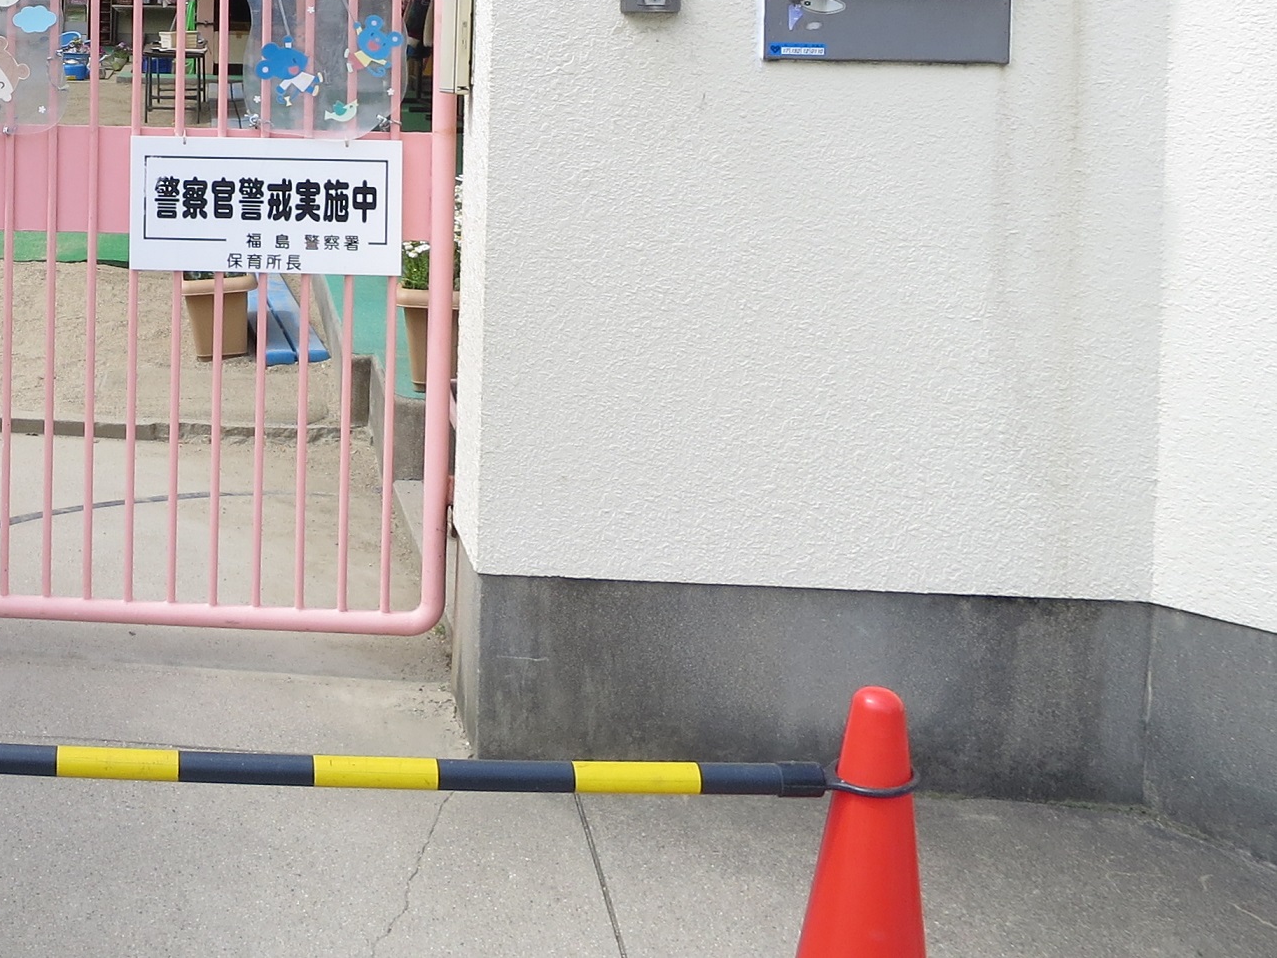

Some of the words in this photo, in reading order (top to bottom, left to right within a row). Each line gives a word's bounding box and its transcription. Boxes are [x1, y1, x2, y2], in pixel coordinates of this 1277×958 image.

[154, 175, 378, 223] 警察官警戒実施中
[246, 233, 360, 251] 福島警察署
[226, 252, 302, 271] 保育所長
